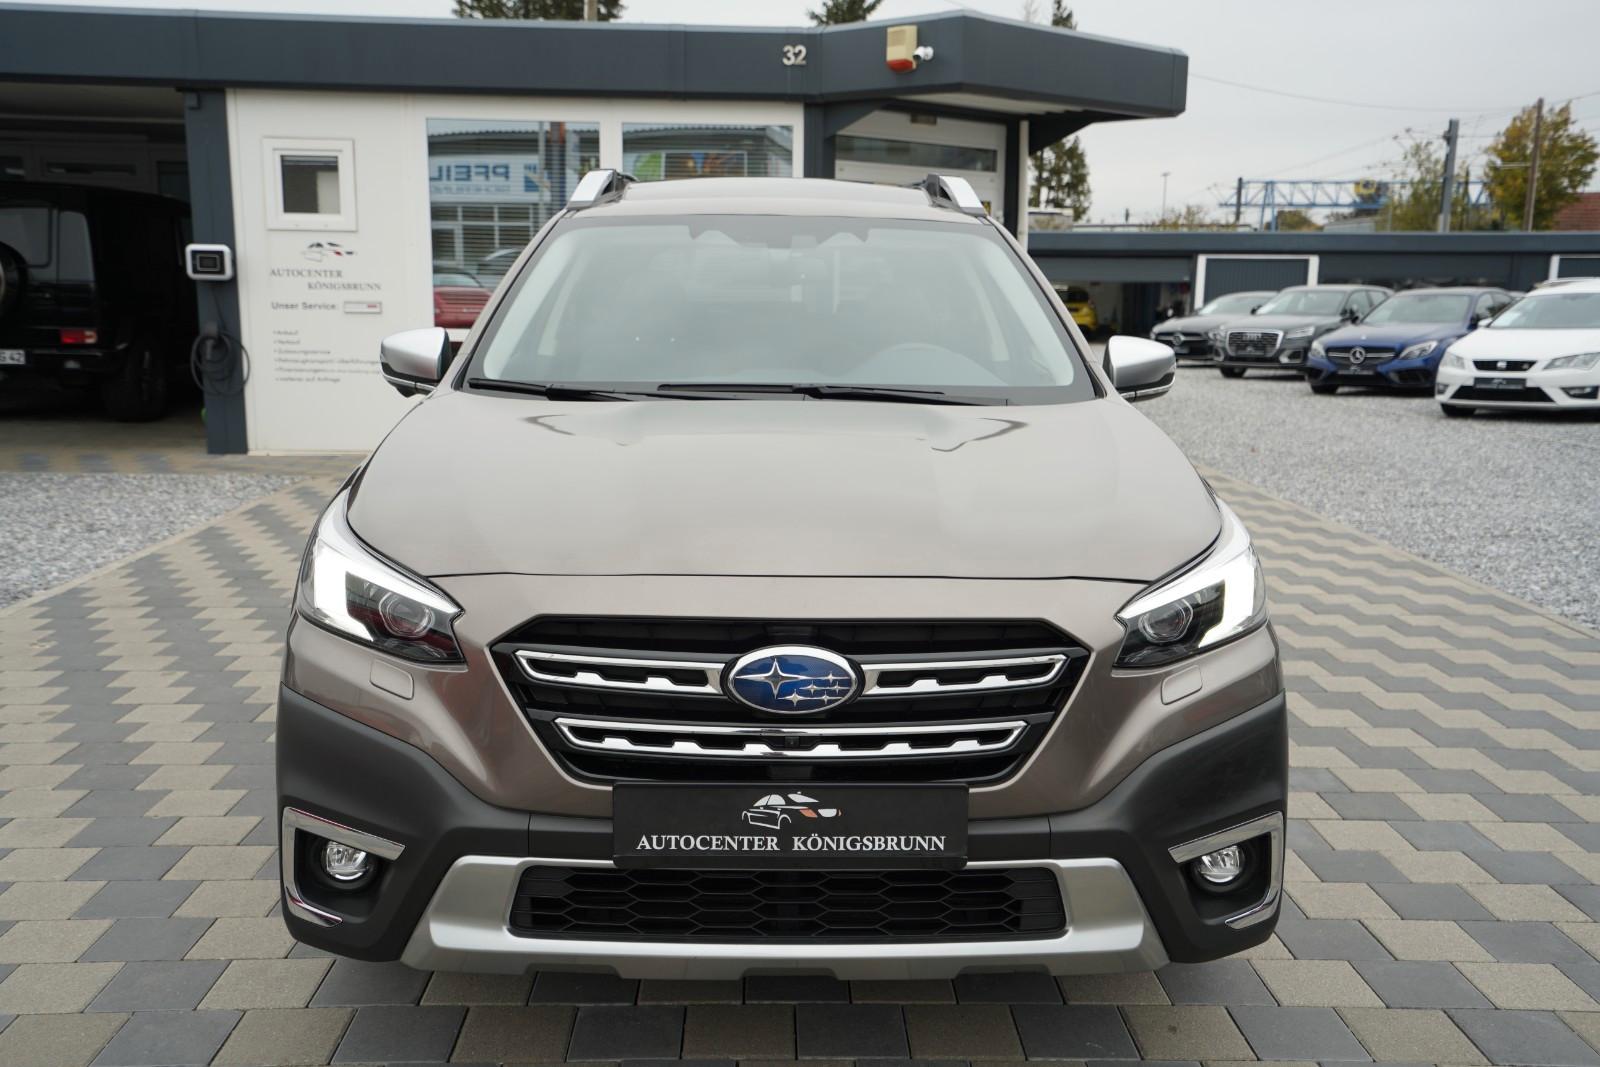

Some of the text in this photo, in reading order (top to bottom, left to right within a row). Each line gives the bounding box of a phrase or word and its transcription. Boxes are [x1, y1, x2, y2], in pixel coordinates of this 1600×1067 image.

[782, 44, 807, 66] 32
[270, 268, 343, 278] AUTOCENTER
[635, 832, 946, 851] AUTOCENTER KÖNIGSBRUNN
